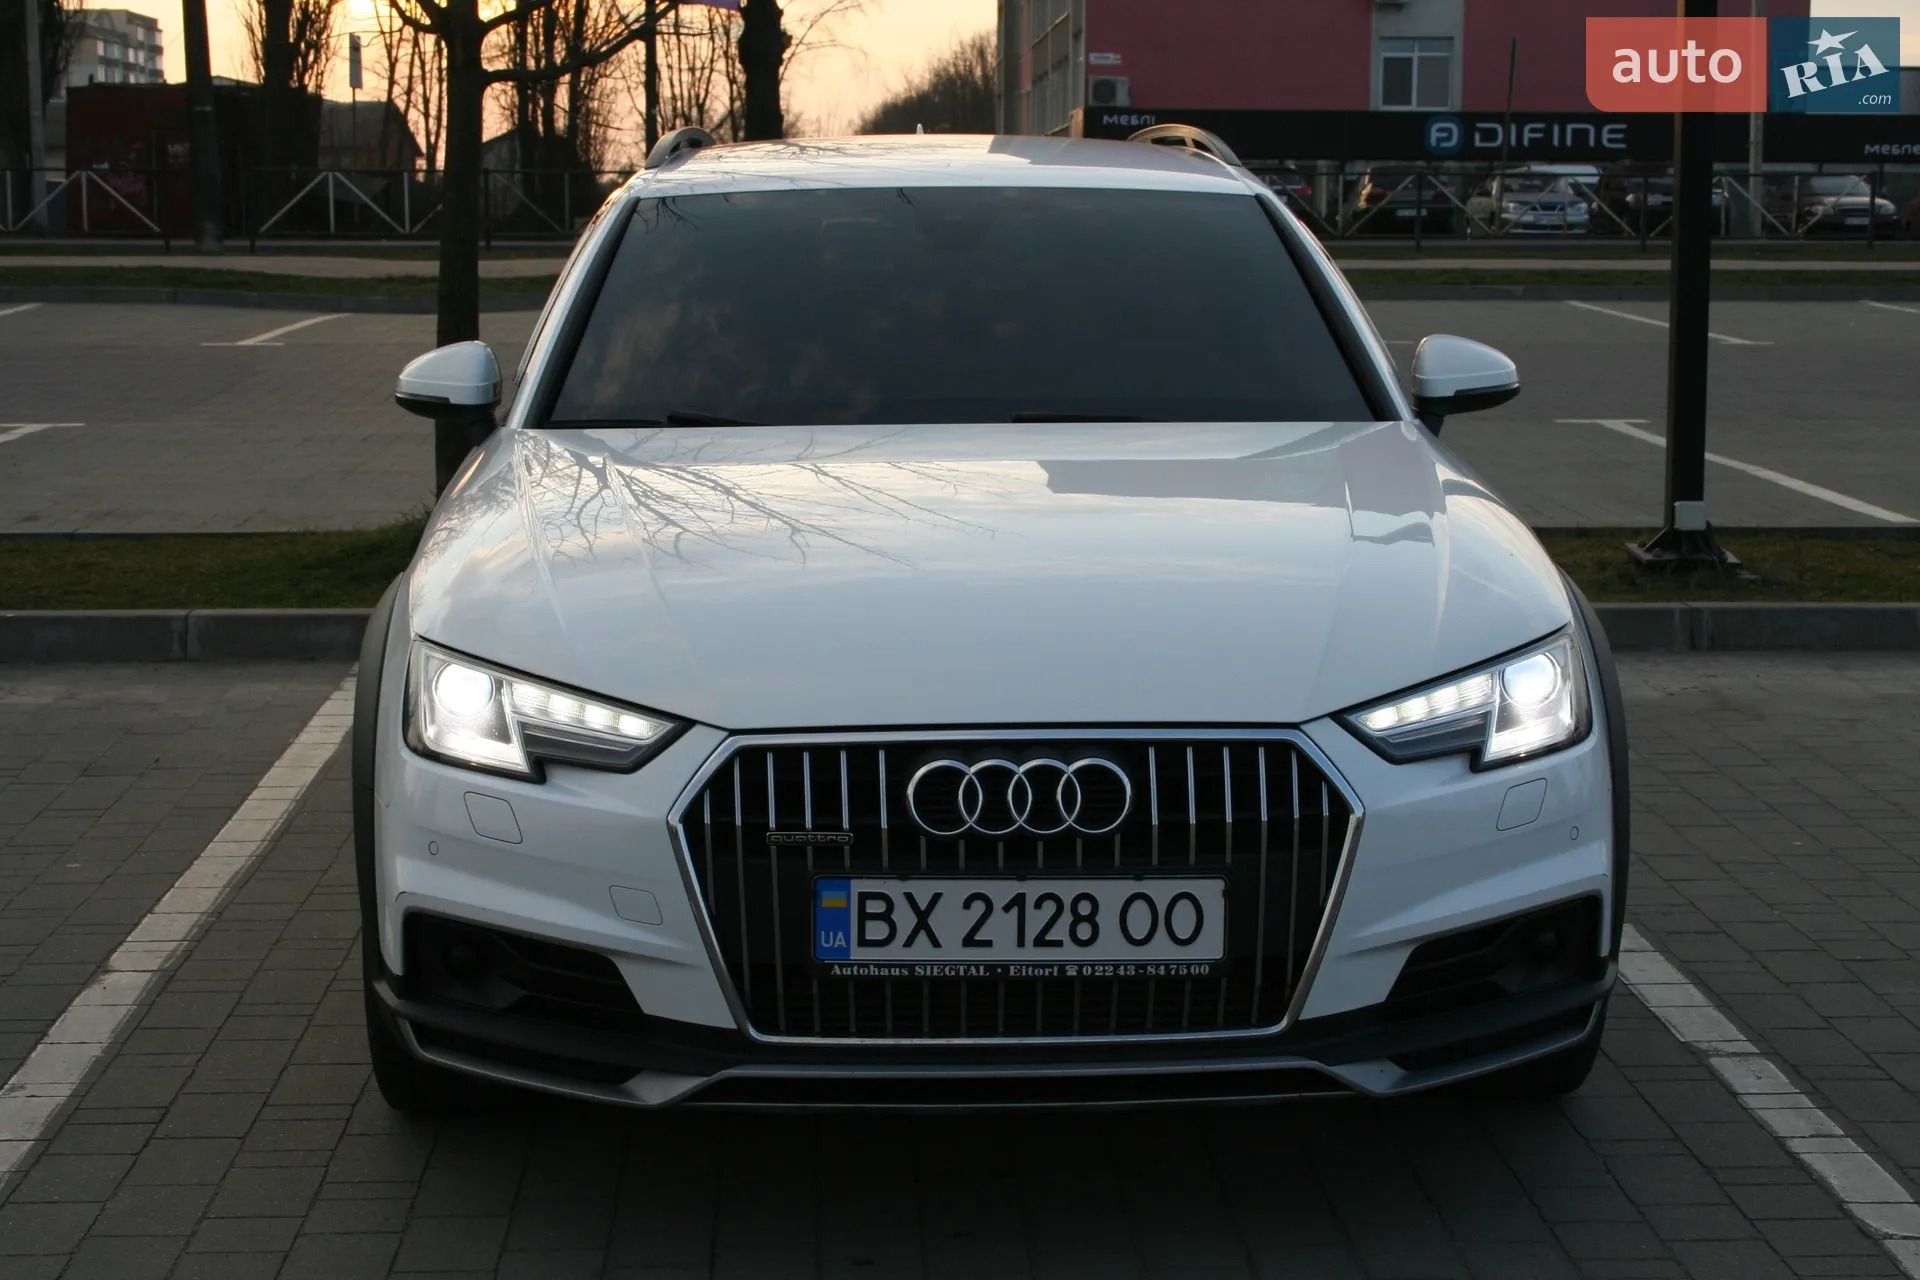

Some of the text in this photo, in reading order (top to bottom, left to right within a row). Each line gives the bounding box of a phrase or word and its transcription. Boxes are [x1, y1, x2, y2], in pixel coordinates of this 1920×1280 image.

[1473, 122, 1628, 149] DIFINE
[770, 834, 849, 843] quattro
[857, 891, 943, 948] BX
[961, 891, 1100, 948] 2128
[820, 930, 847, 948] UA
[830, 964, 909, 976] Autohaus
[914, 964, 990, 976] SIEGTAL
[1009, 964, 1059, 976] Eitorf
